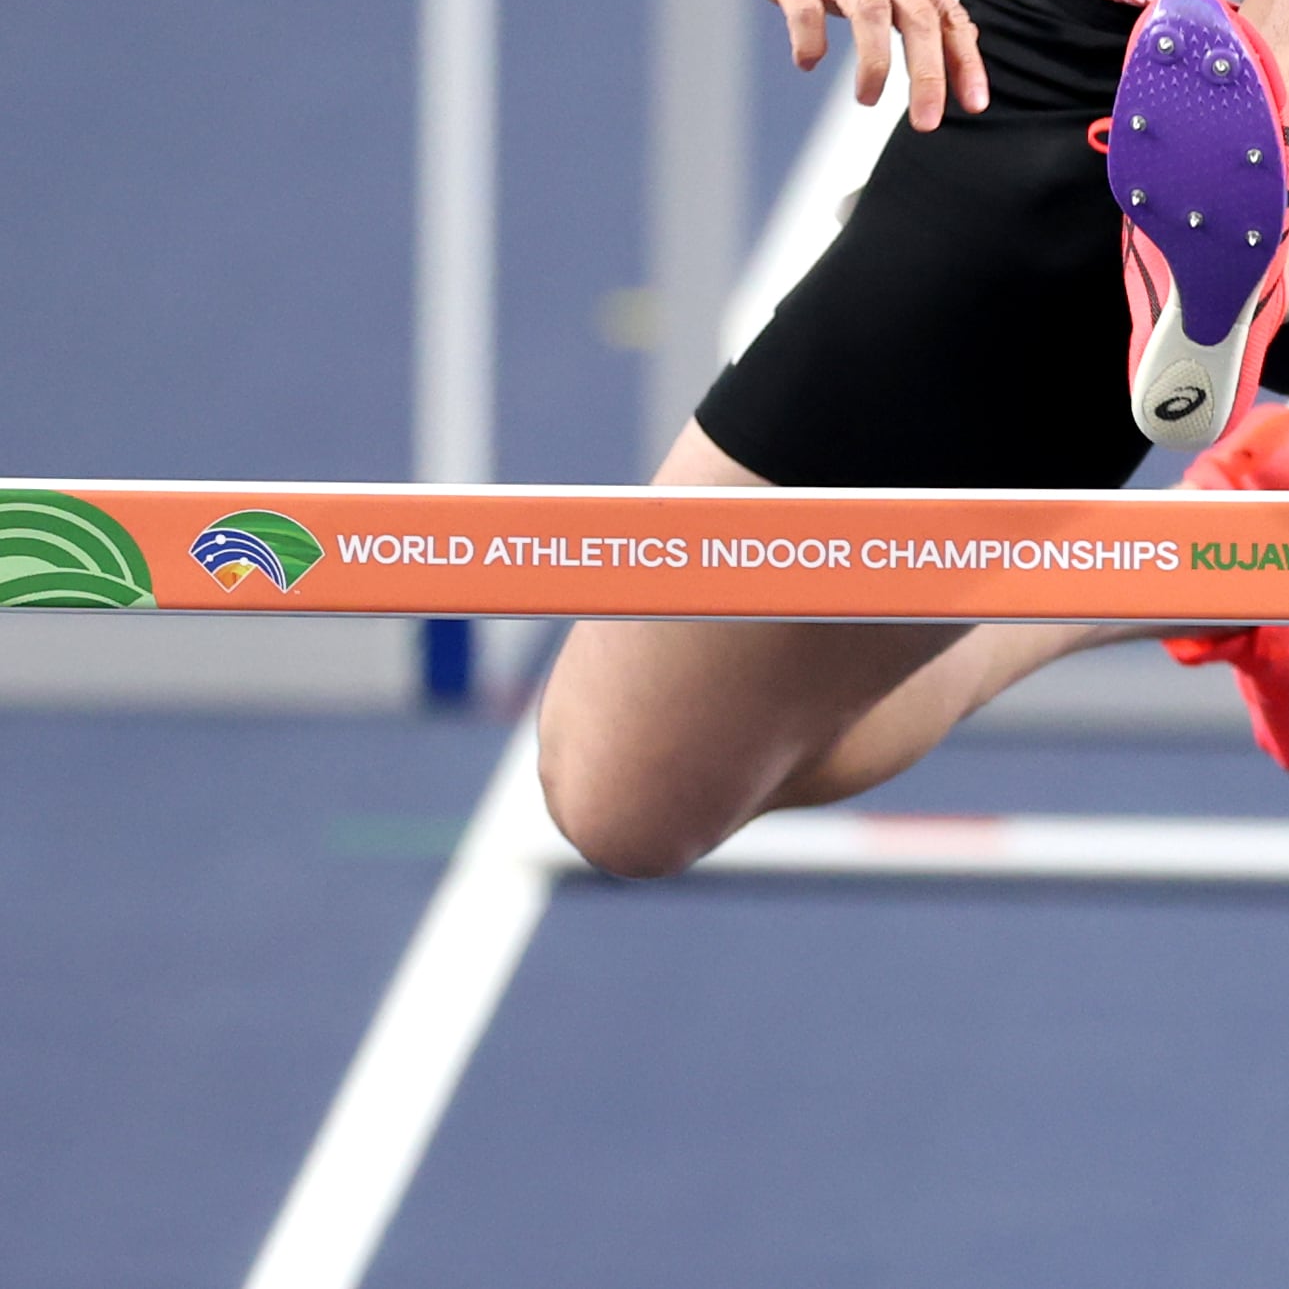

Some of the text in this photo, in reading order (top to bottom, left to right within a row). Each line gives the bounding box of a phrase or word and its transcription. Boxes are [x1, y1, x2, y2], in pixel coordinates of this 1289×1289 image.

[337, 534, 474, 565] WORLD
[484, 536, 688, 568] ATHLETICS
[702, 538, 850, 569] INDOOR
[861, 539, 1179, 571] CHAMPIONSHIPS
